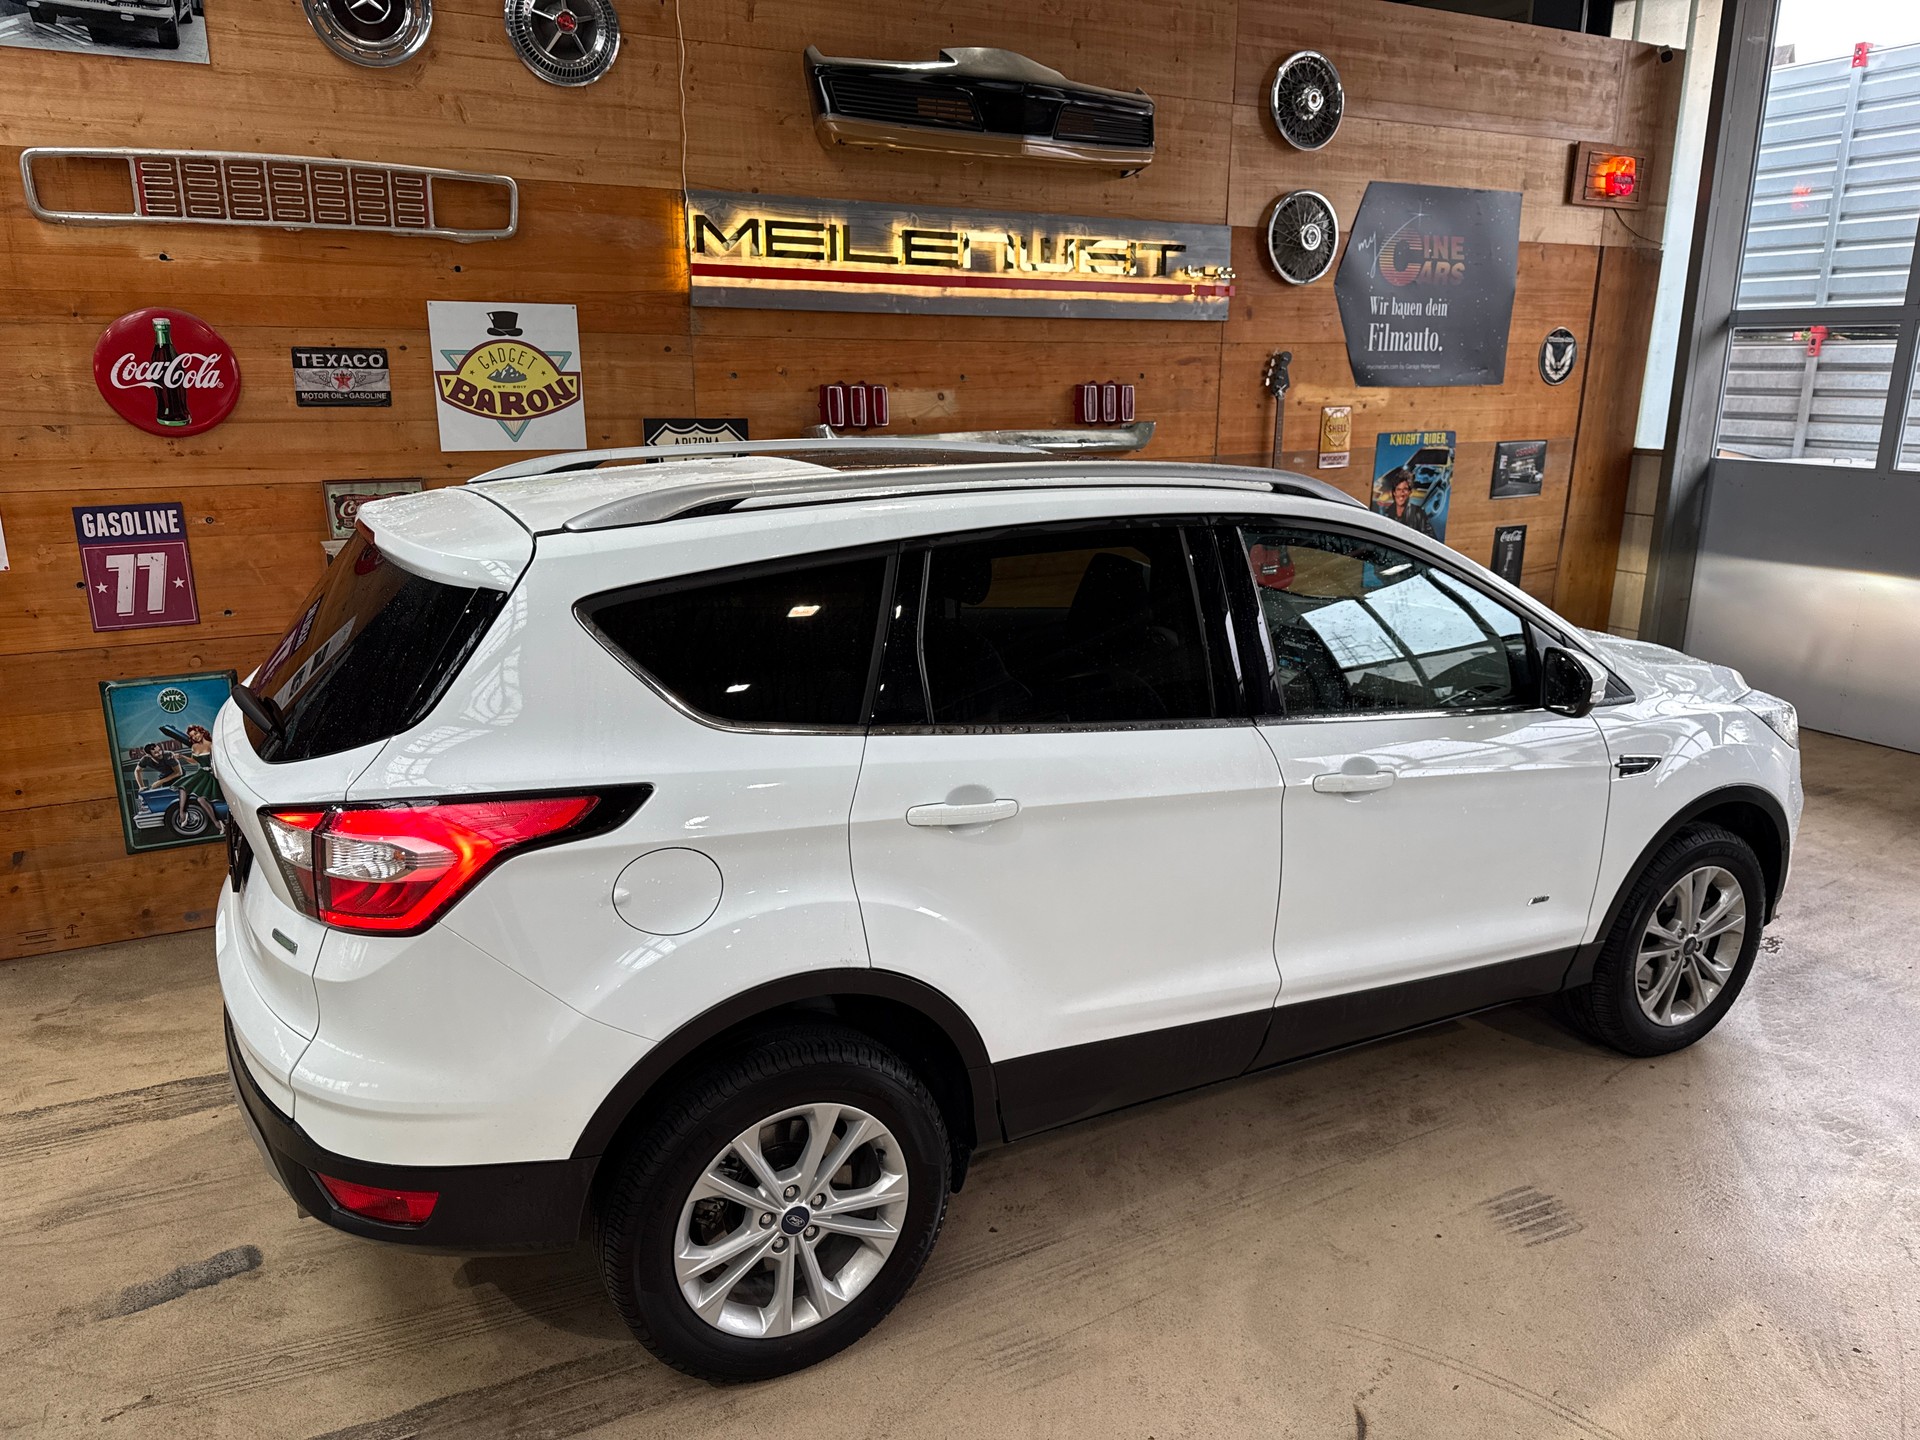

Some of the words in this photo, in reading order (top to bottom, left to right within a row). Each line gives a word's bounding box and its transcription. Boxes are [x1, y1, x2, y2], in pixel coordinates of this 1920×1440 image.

[694, 214, 1187, 276] MEILENWEIT
[1369, 295, 1389, 315] Wir
[1391, 296, 1423, 316] bauen
[1425, 297, 1449, 317] dein
[1367, 322, 1443, 352] Filmauto.
[296, 353, 384, 368] TEXACO
[477, 347, 538, 370] GADGET
[110, 352, 223, 390] Coca-Cola
[301, 392, 330, 400] MOTOR
[331, 392, 344, 400] OIL
[349, 392, 387, 400] GASOLINE
[446, 377, 576, 416] BARON
[1328, 424, 1347, 433] SHELL
[1389, 433, 1421, 446] KNIGHT
[1424, 432, 1447, 445] RIDER
[81, 509, 180, 538] GASOLINE
